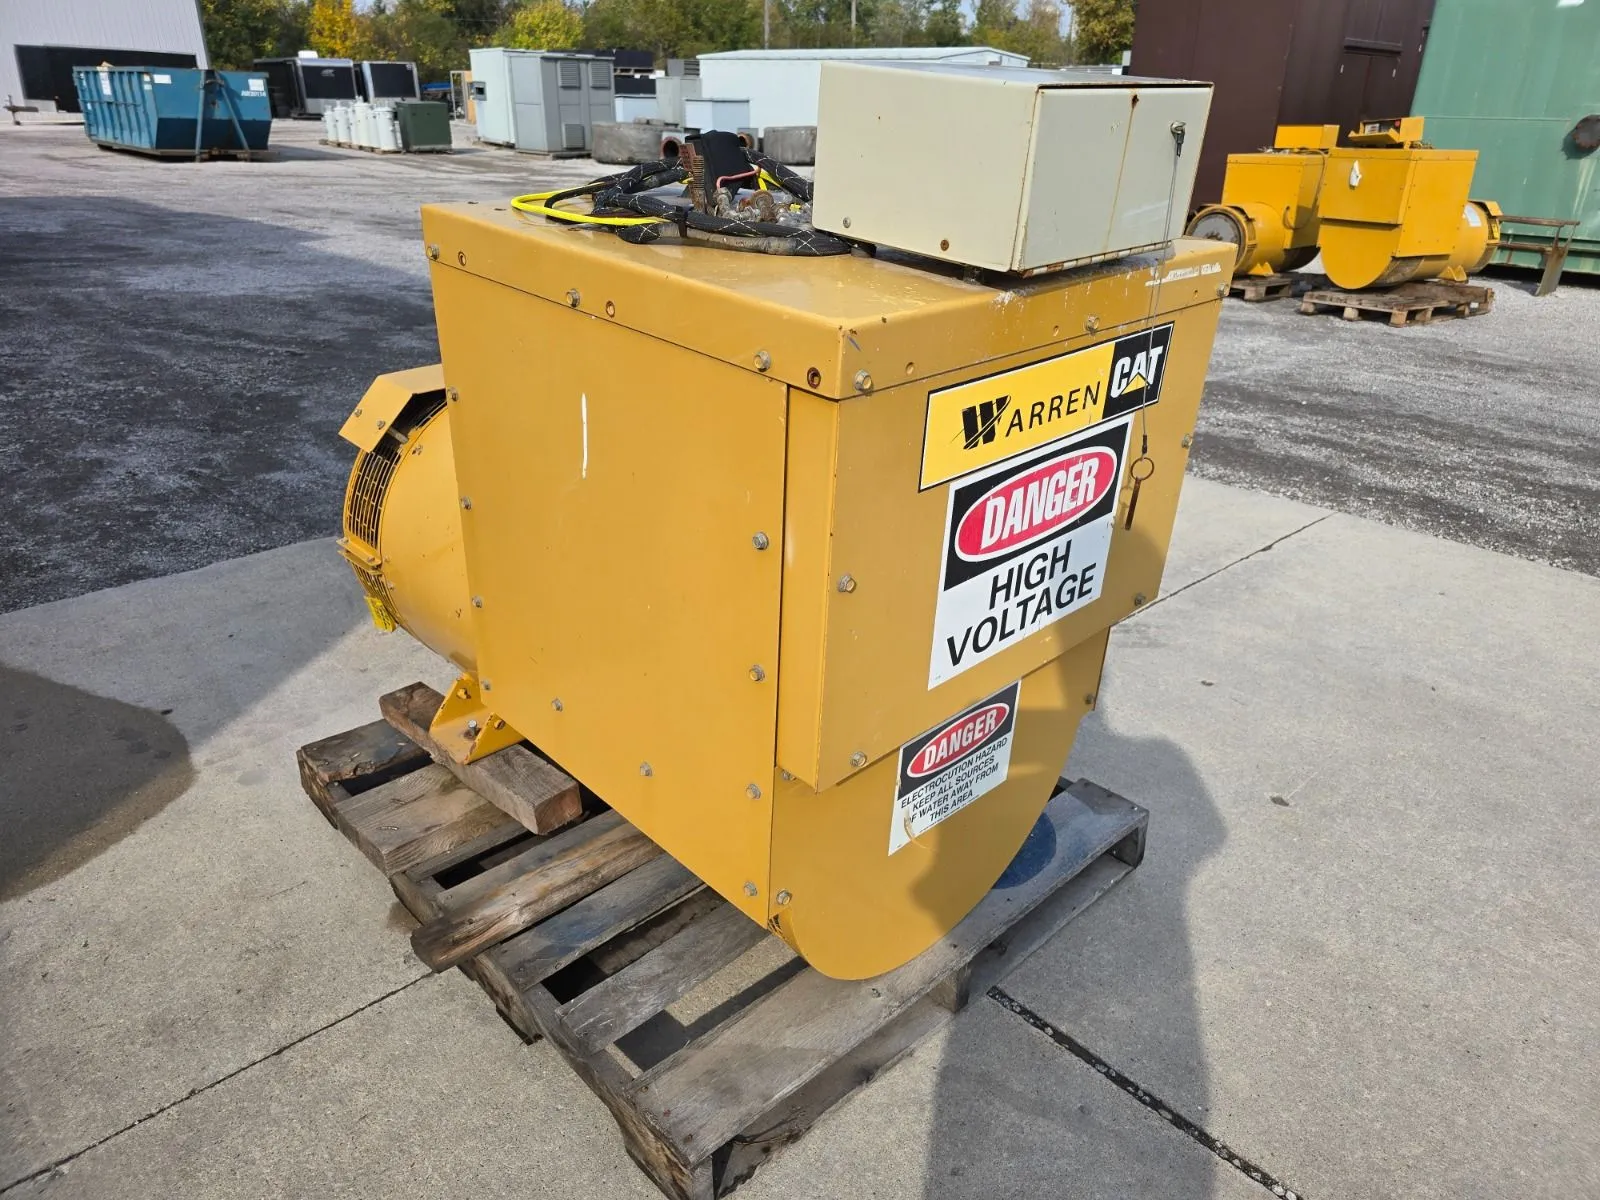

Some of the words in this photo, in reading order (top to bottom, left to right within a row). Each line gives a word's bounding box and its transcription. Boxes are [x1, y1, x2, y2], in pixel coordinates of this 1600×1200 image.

[962, 380, 1101, 450] WARREN
[1110, 345, 1164, 399] CAT
[980, 457, 1100, 550] DANGER
[989, 539, 1073, 610] HIGH
[946, 562, 1097, 667] VOLTAGE
[901, 758, 974, 808] ELECTROCUTION
[975, 737, 1008, 762] HAZARD
[922, 708, 998, 772] DANGER
[912, 792, 936, 812] KEEP
[937, 781, 953, 797] ALL
[955, 755, 995, 786] SOURCES
[919, 794, 949, 818] WATER
[950, 778, 975, 799] AWAY
[975, 762, 999, 783] FROM
[929, 804, 949, 821] THIS
[950, 790, 973, 809] AREA
